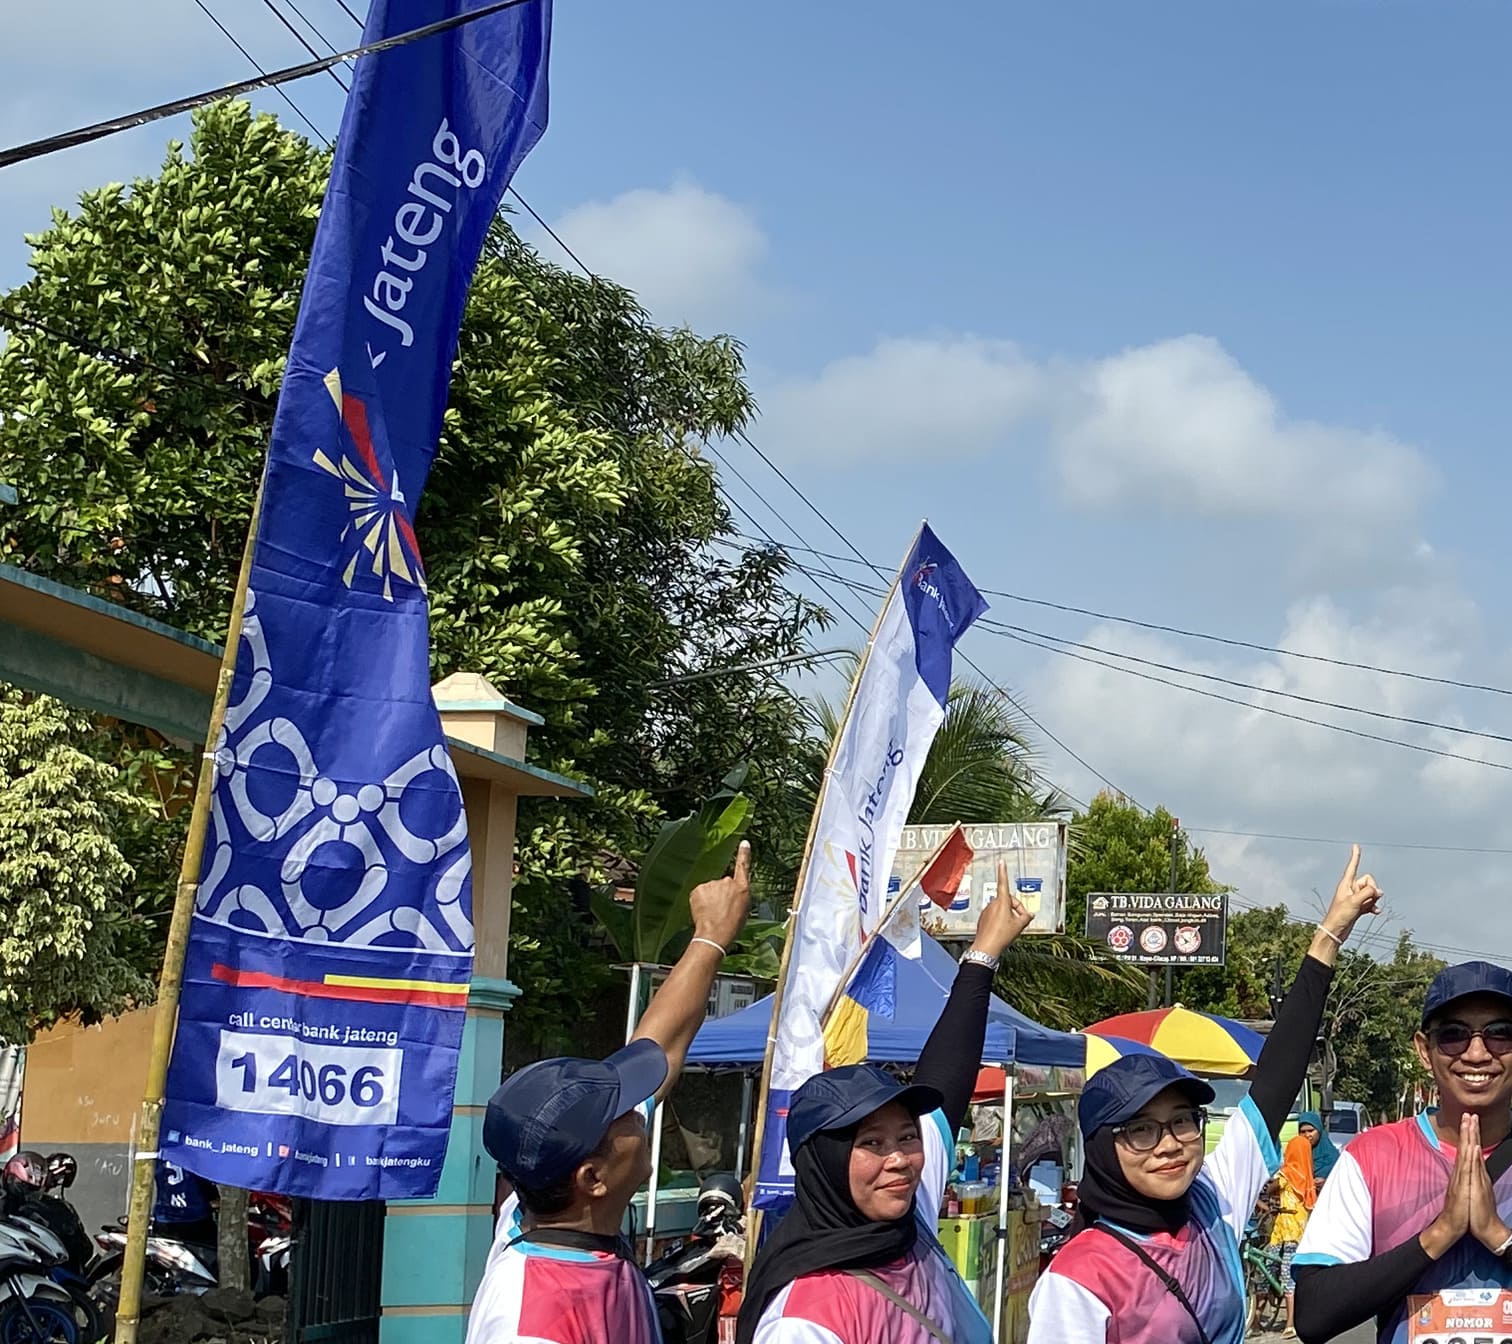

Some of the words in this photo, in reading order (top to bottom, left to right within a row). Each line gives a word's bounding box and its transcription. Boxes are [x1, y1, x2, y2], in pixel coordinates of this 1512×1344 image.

[363, 117, 486, 348] Jateng
[970, 829, 1049, 849] GALANG
[1110, 896, 1163, 909] TB.VIDA
[1165, 896, 1222, 910] GALANG
[229, 1012, 254, 1028] call
[302, 1023, 340, 1040] bank
[343, 1026, 398, 1046] jateng
[231, 1051, 384, 1107] 14066
[1445, 1318, 1493, 1328] NOMOR
